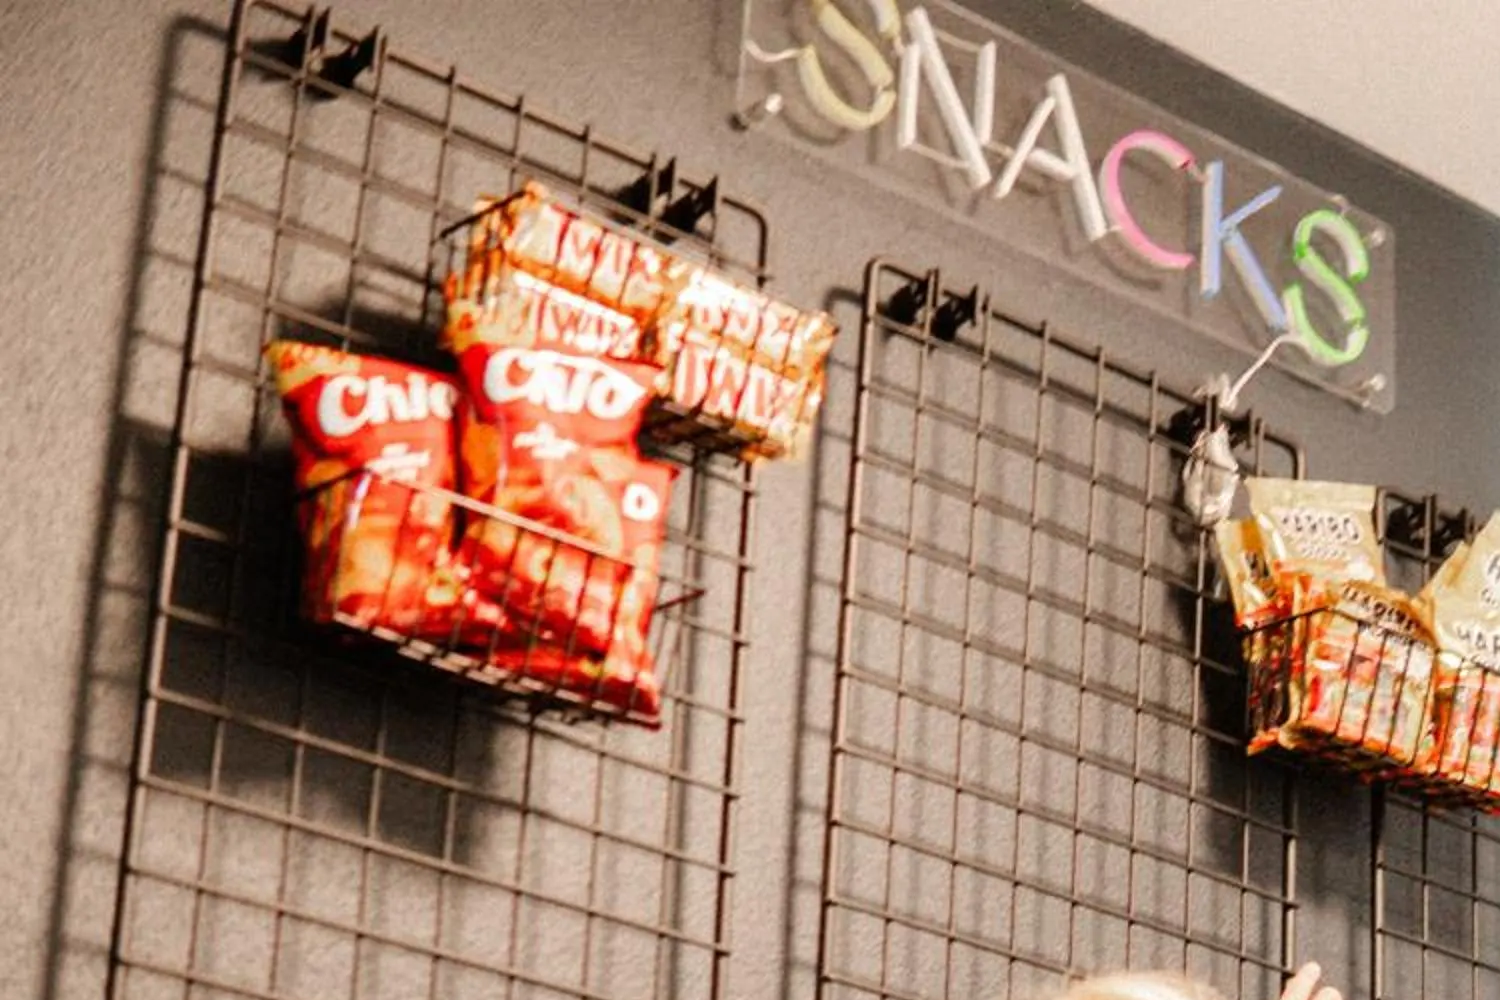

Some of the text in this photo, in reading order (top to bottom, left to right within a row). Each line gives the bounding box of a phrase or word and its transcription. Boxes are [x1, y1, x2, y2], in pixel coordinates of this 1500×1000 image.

[797, 0, 1369, 365] SNACKS
[317, 371, 458, 437] Chio
[483, 348, 648, 421] Chio
